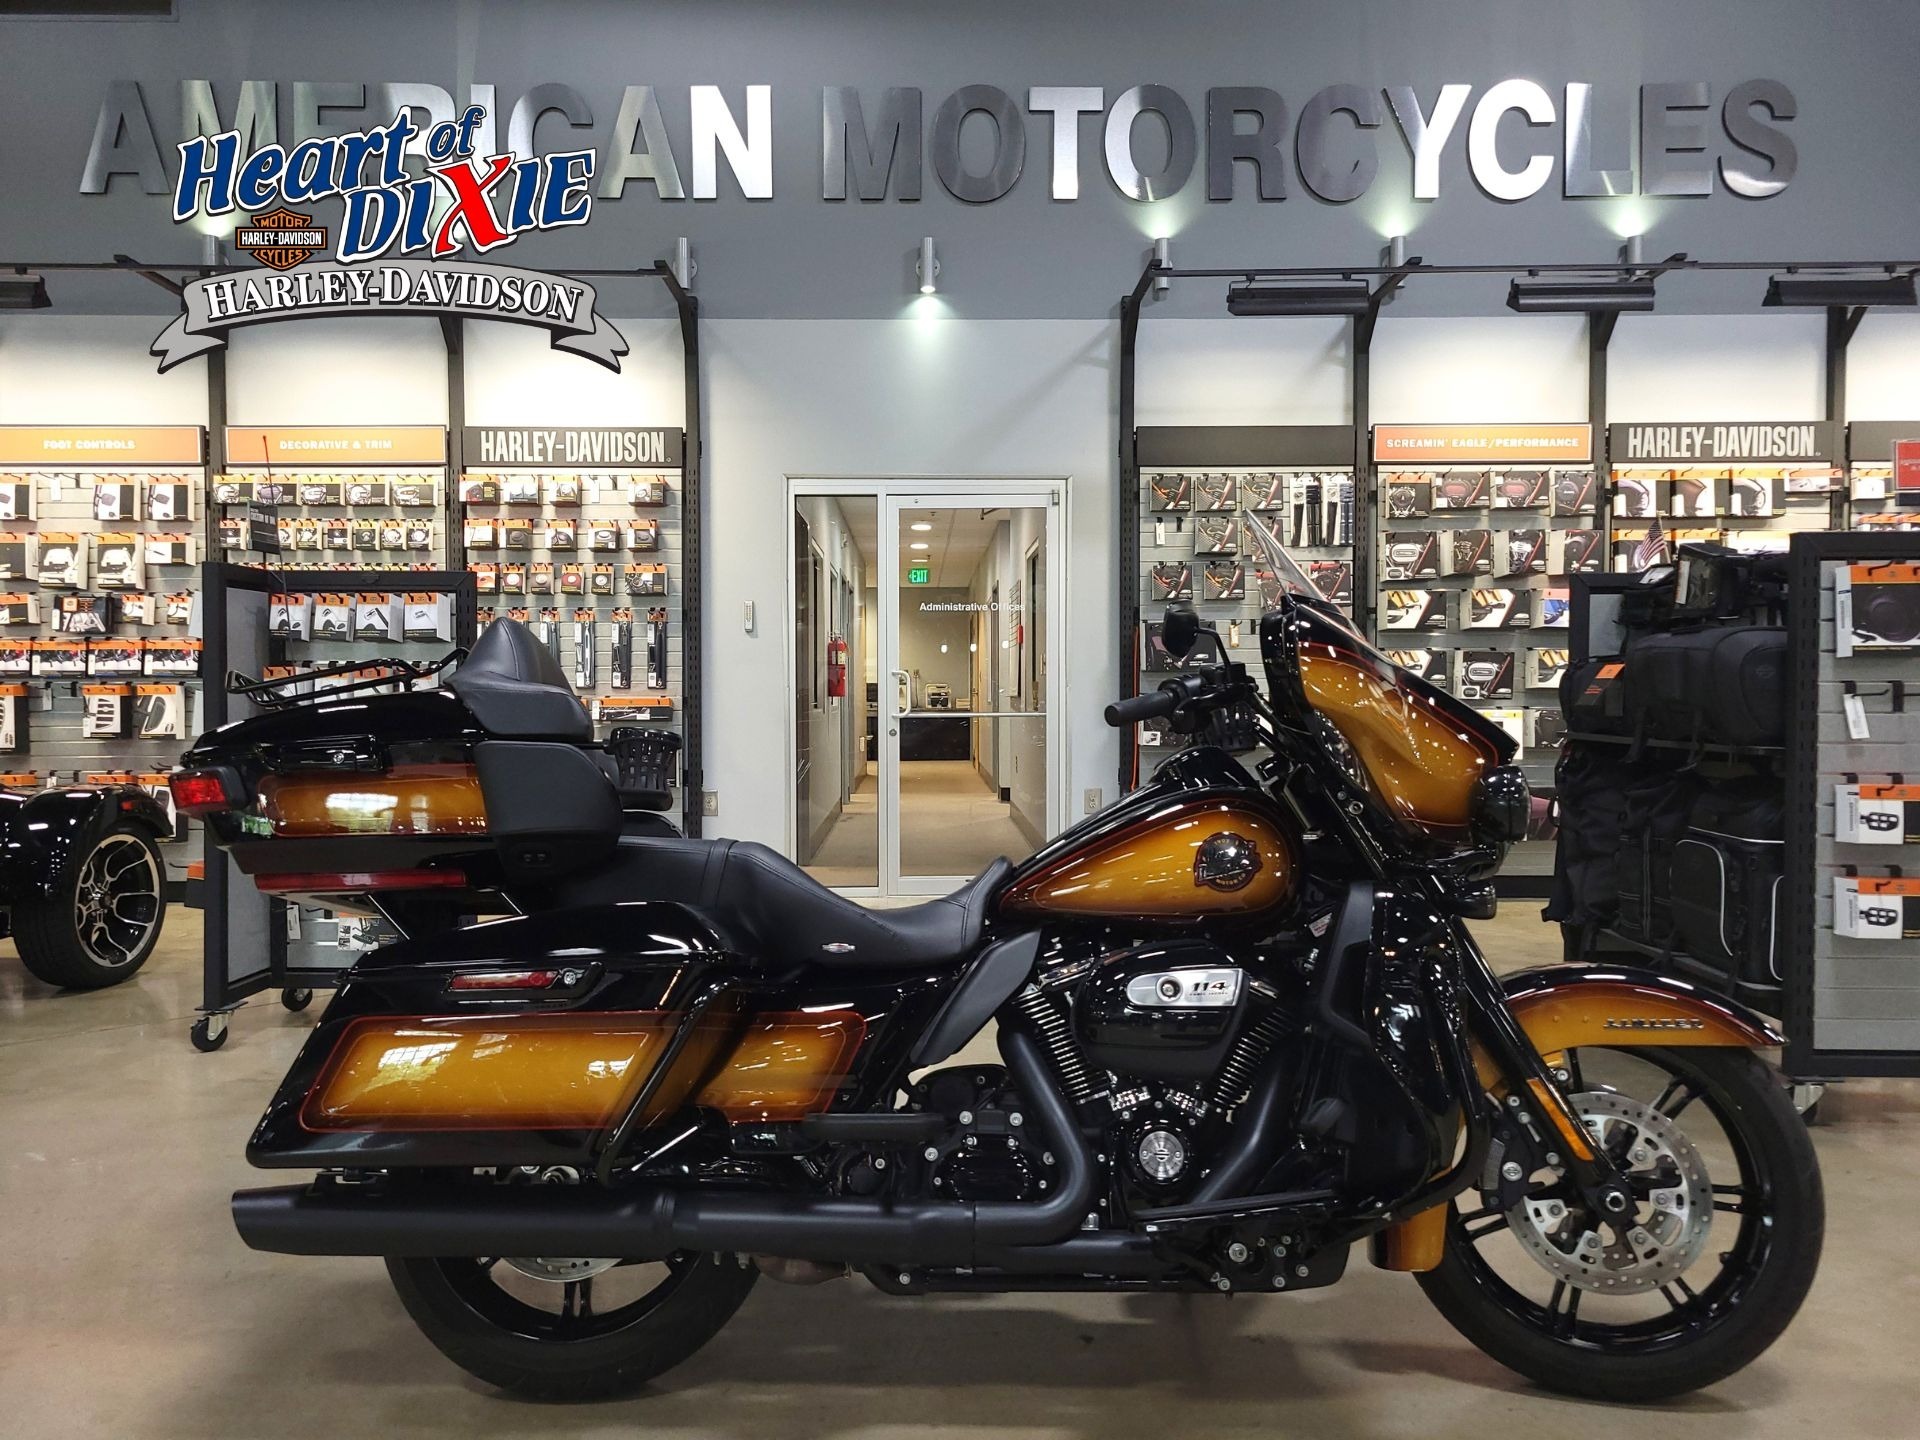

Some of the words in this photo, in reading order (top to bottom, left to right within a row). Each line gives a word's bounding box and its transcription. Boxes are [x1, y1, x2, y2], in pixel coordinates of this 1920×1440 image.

[822, 79, 1800, 203] MOTORCYCLES
[43, 440, 72, 449] FOOT
[75, 440, 136, 449] CONTROLS
[279, 440, 350, 449] DECORATIVE
[352, 440, 362, 449] &
[365, 439, 393, 449] TRIM
[480, 430, 665, 463] HARLEY-DAVIDSON
[1627, 426, 1816, 458] HARLEY-DAVIDSON
[911, 569, 928, 583] EXIT
[919, 602, 988, 611] Administrative
[1192, 981, 1228, 993] 114
